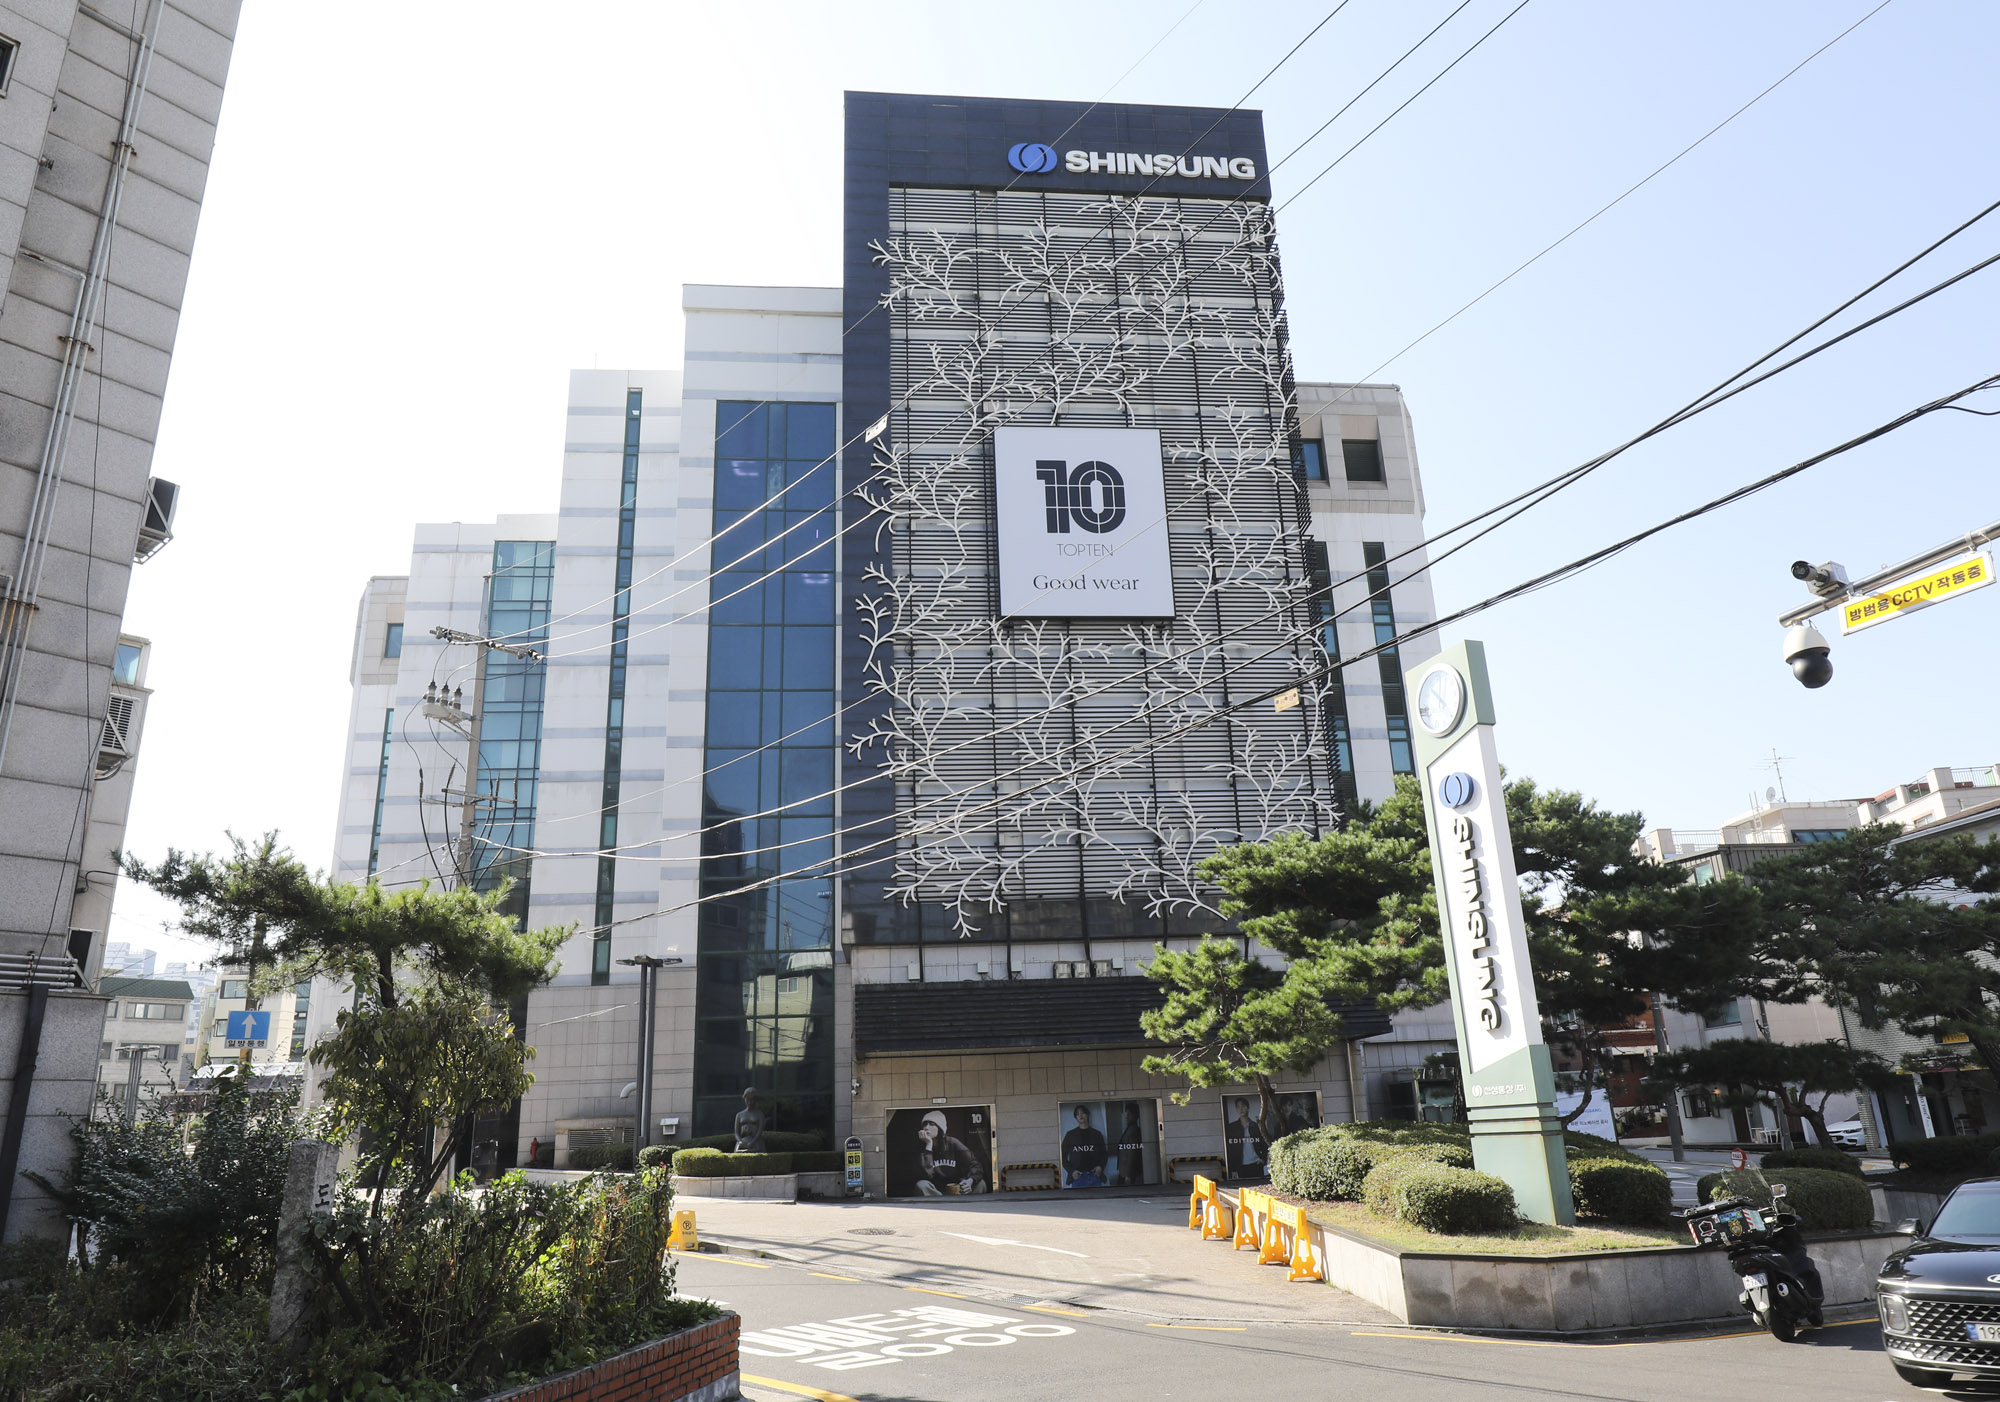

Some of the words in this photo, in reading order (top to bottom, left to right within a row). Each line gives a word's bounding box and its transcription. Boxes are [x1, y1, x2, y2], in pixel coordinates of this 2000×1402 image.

[1065, 150, 1256, 179] SHINSUNG
[1036, 460, 1126, 533] 10
[1056, 543, 1114, 556] TOPTEN
[1033, 574, 1086, 590] Good
[1093, 579, 1139, 590] wear
[1850, 598, 1889, 621] 방범용
[1892, 582, 1933, 606] CCTV
[1937, 565, 1981, 588] 작동중
[1454, 816, 1502, 1031] SHINSUNG
[1483, 1085, 1513, 1095] 신성통상
[972, 1114, 982, 1123] 10
